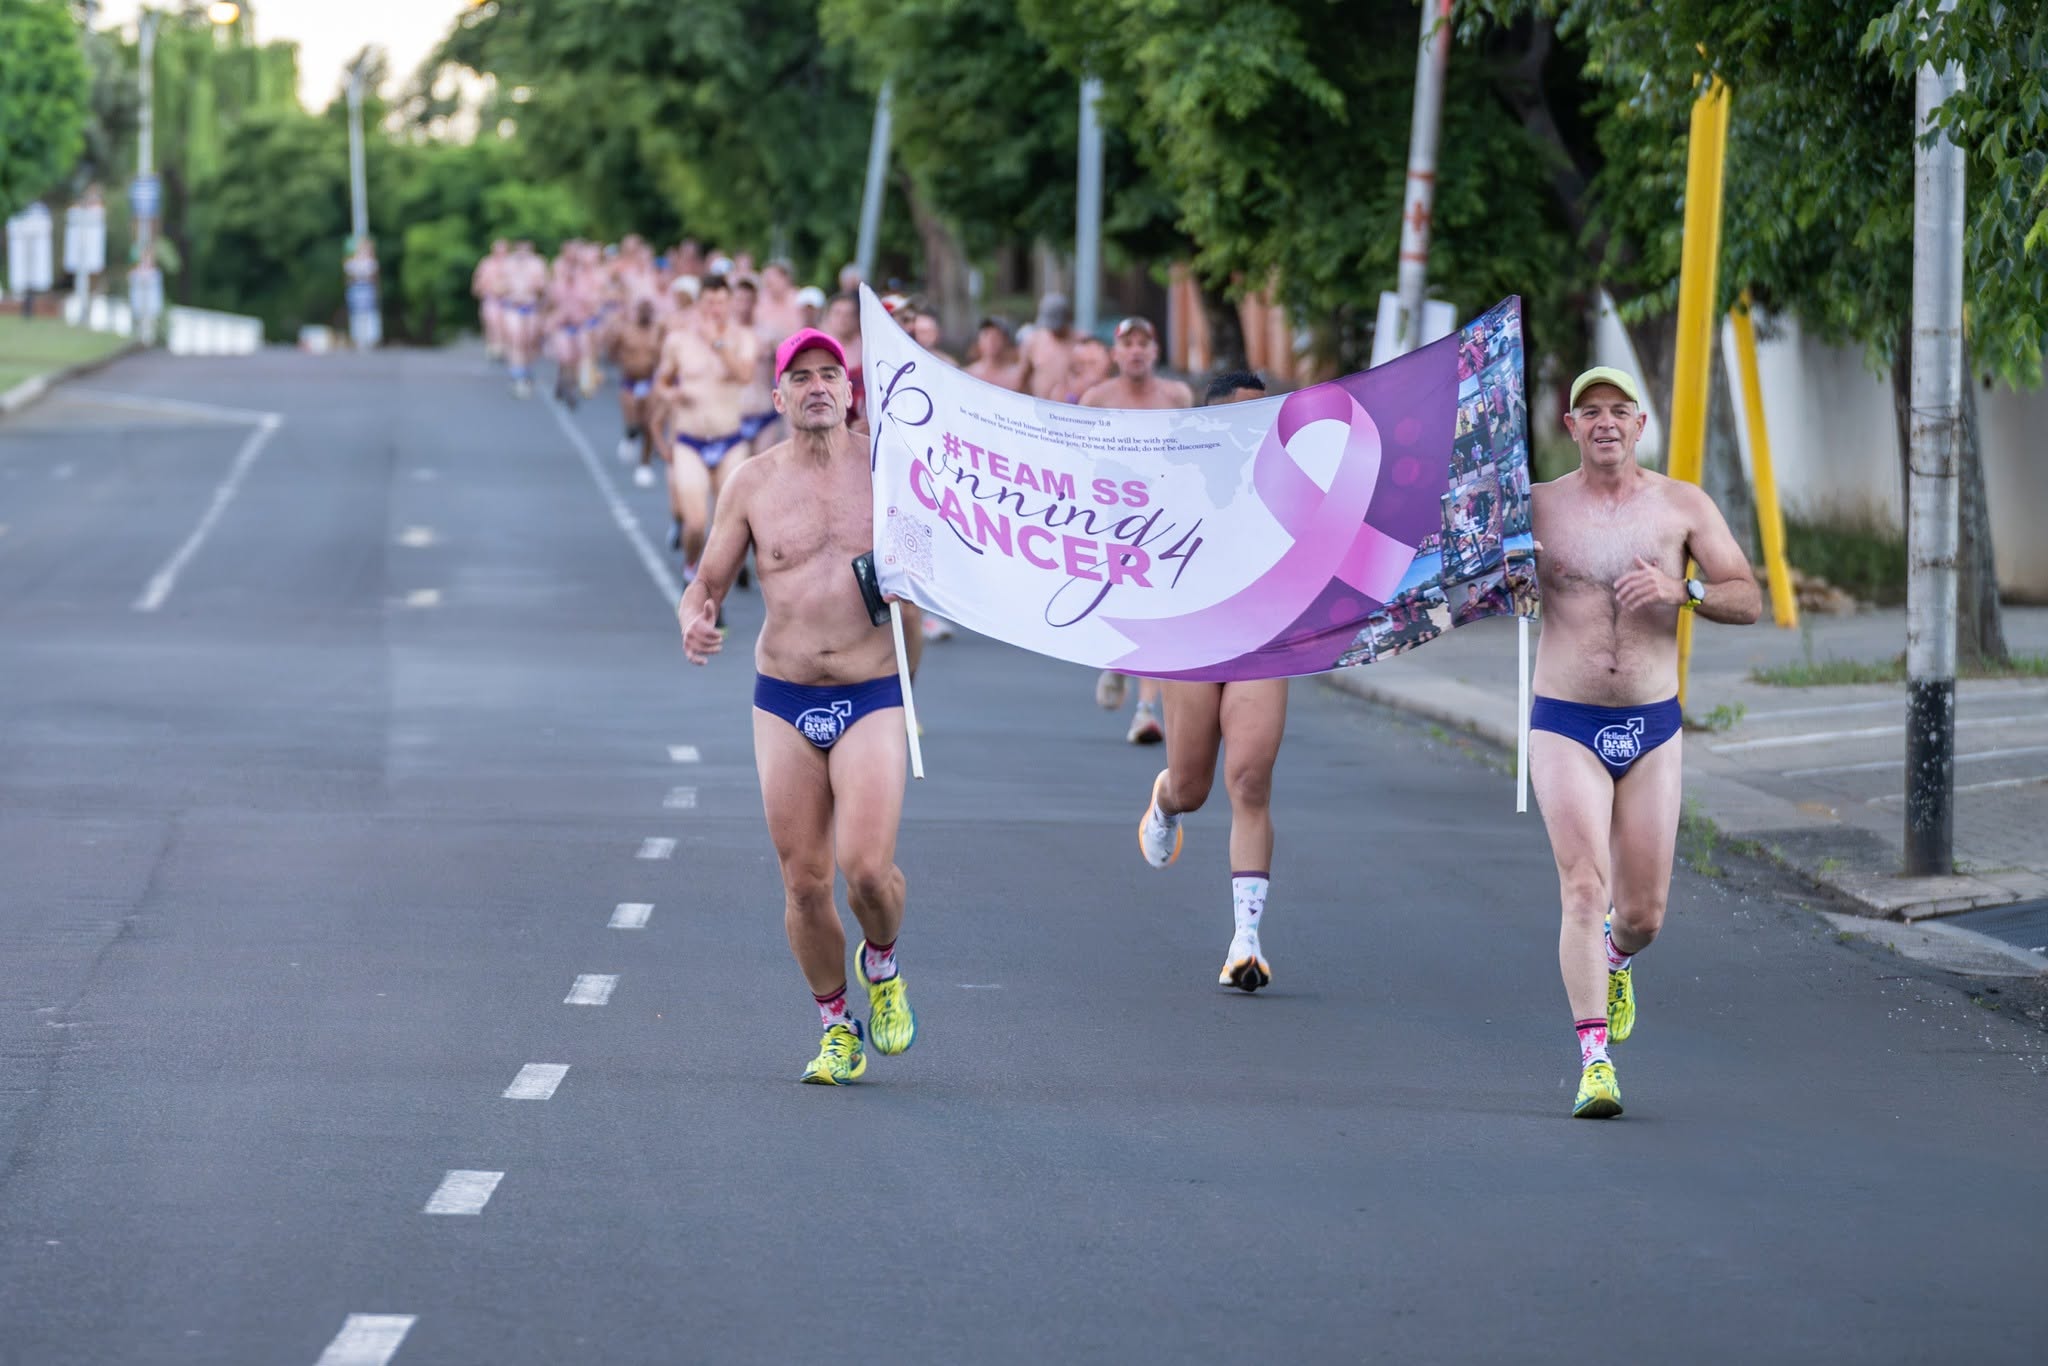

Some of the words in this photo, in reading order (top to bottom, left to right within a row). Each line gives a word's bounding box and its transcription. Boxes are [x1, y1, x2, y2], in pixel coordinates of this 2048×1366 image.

[968, 411, 979, 421] will
[1082, 441, 1093, 449] Do
[1107, 444, 1116, 452] be
[1167, 444, 1177, 452] be
[994, 413, 1005, 423] The
[1007, 417, 1022, 428] Lord
[1023, 422, 1047, 433] himself
[1064, 431, 1086, 441] before
[1088, 435, 1101, 443] you
[1117, 436, 1131, 444] will
[1143, 436, 1161, 444] with
[942, 431, 1076, 500] #TEAM
[1092, 478, 1150, 508] SS
[909, 458, 1154, 589] CANCER
[1158, 518, 1203, 590] 4
[804, 721, 836, 733] DARE
[1602, 739, 1634, 750] DARE
[1603, 748, 1632, 758] DEVIL
